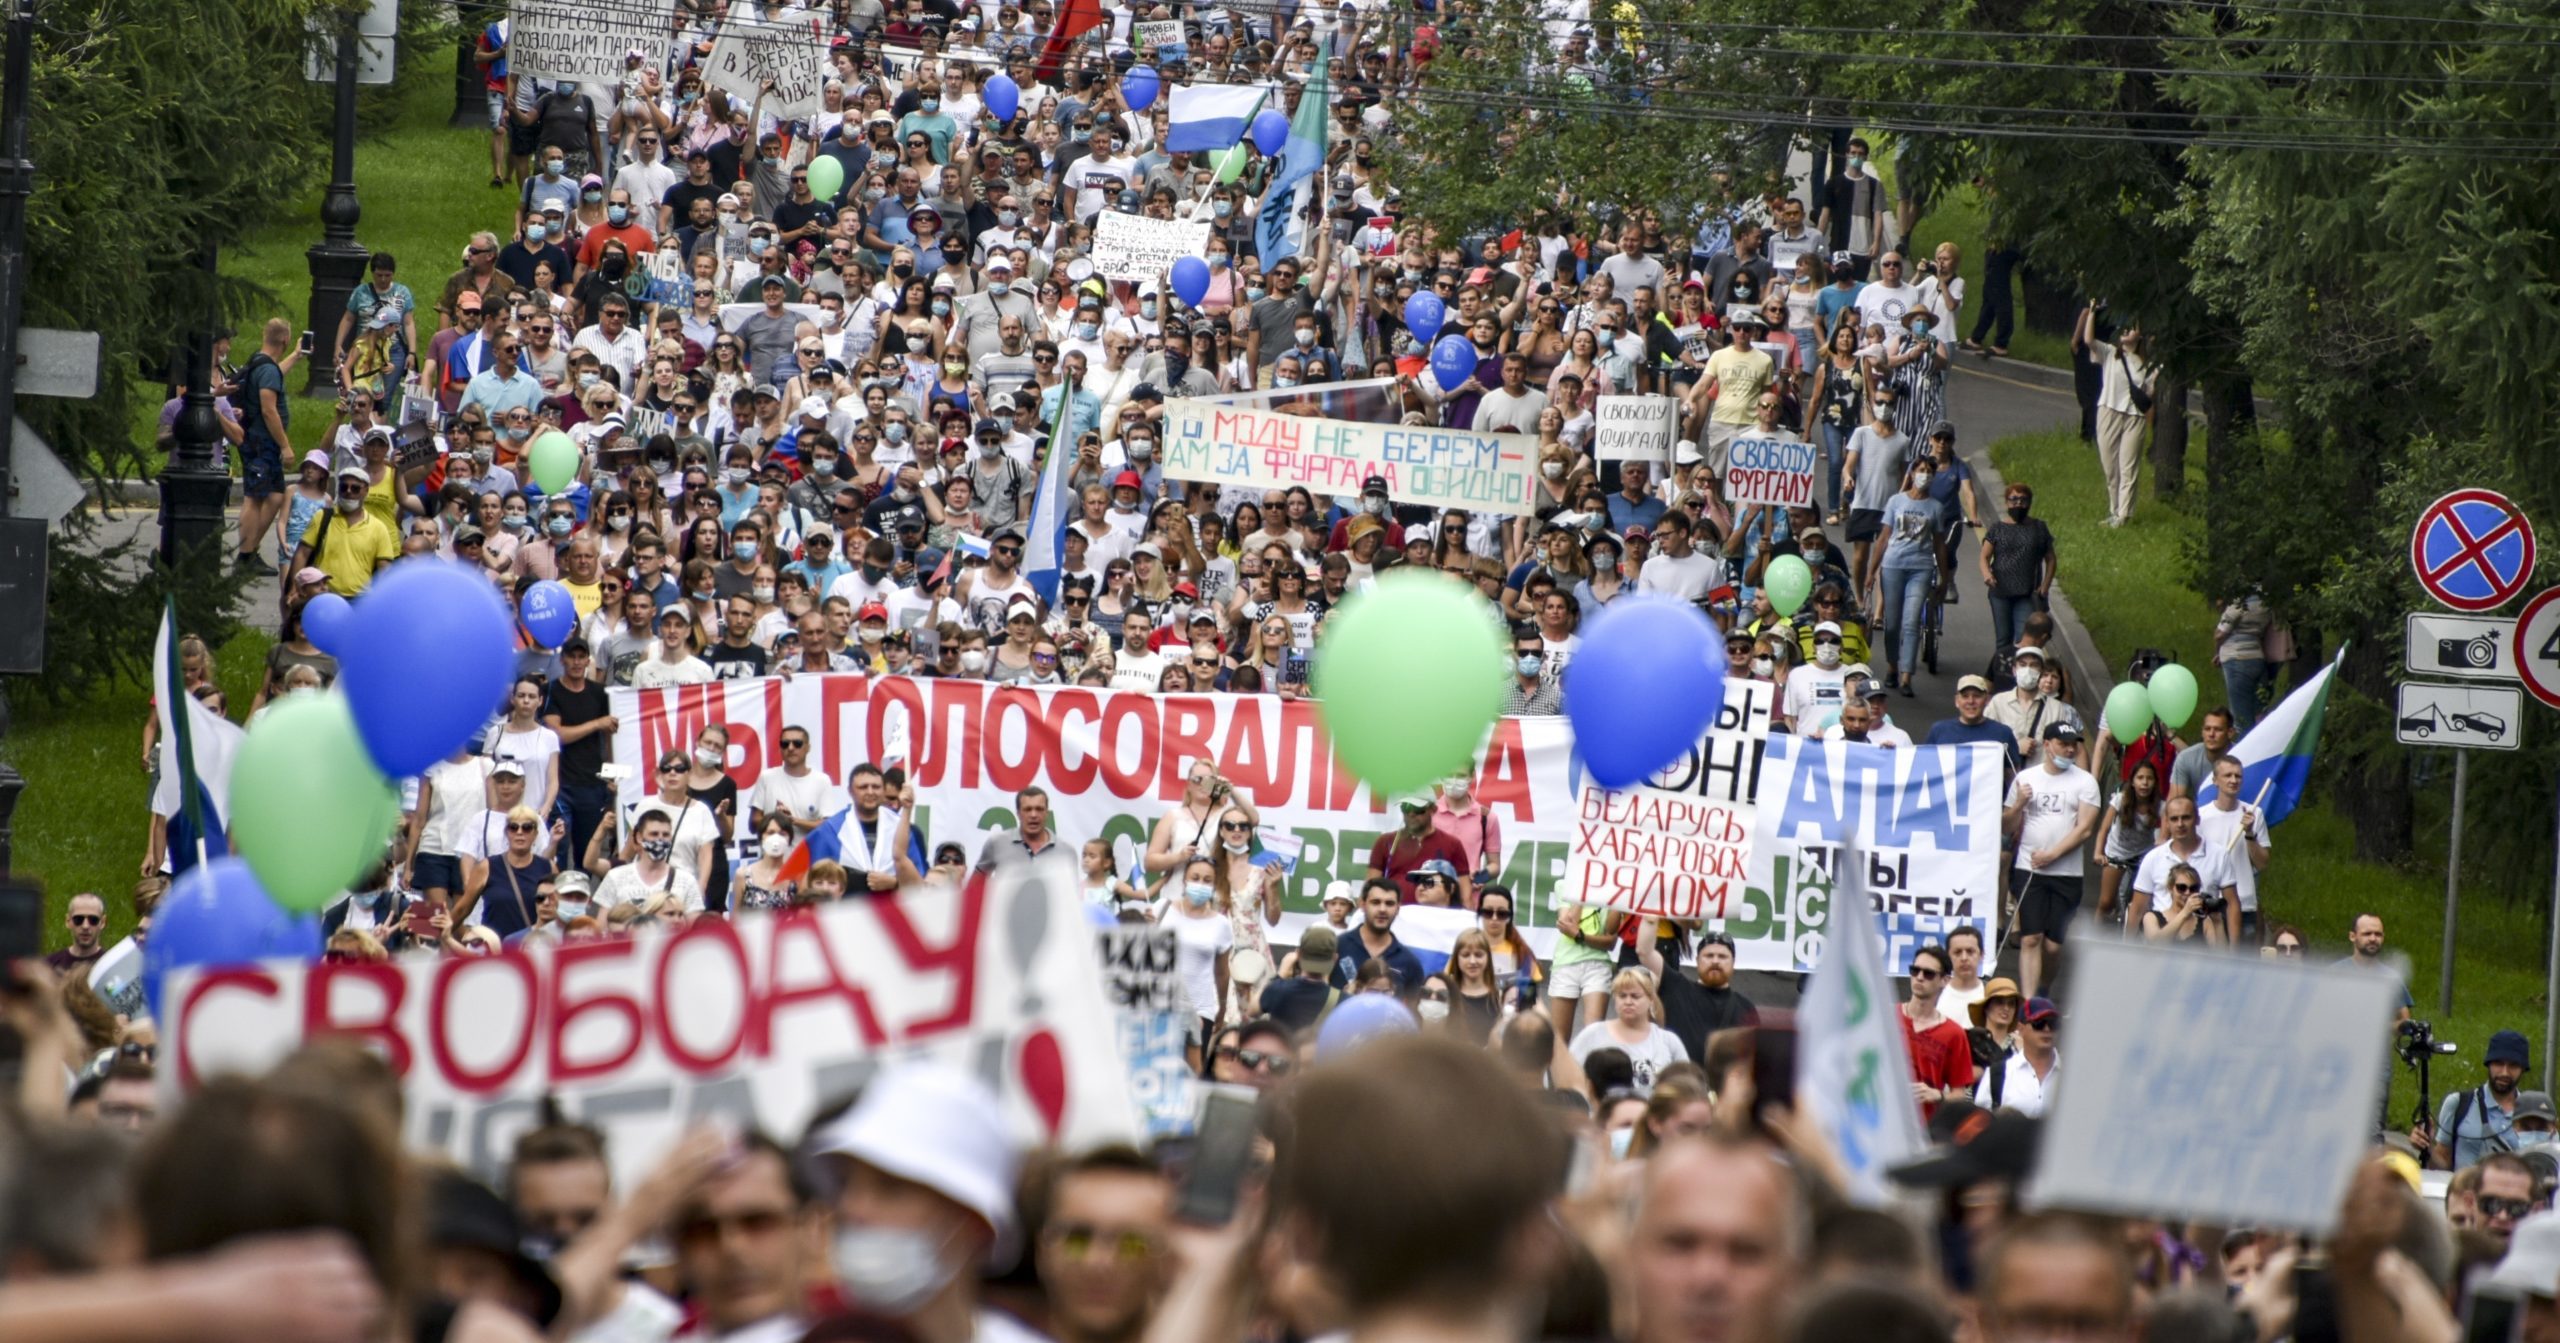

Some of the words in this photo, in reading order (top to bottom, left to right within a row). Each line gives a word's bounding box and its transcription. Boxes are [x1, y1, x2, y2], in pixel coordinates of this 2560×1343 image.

[518, 6, 609, 33] ИНТЕРЕСОВ
[513, 30, 598, 54] СОЗДАДИМ
[603, 36, 664, 59] ПАРТИЮ
[723, 52, 736, 72] В
[1603, 404, 1668, 421] СВОБОДУ
[1214, 410, 1301, 451] МЗДУ
[1314, 424, 1362, 458] НЕ
[1600, 427, 1671, 450] ФУРГАЛУ
[1215, 443, 1250, 476] ЗА
[1264, 448, 1398, 492] ФУРГАЛА
[1411, 464, 1532, 505] ОБИДНО!
[1729, 440, 1816, 474] СВОБОДУ
[1728, 467, 1814, 505] ФУРГАЛУ
[638, 677, 783, 796] МЫ
[1582, 787, 1746, 844] БЕЛАРУСЬ
[2042, 794, 2060, 809] 27
[1576, 822, 1749, 882] ХАБАРОВСК
[1581, 860, 1730, 919] РЯДОМ
